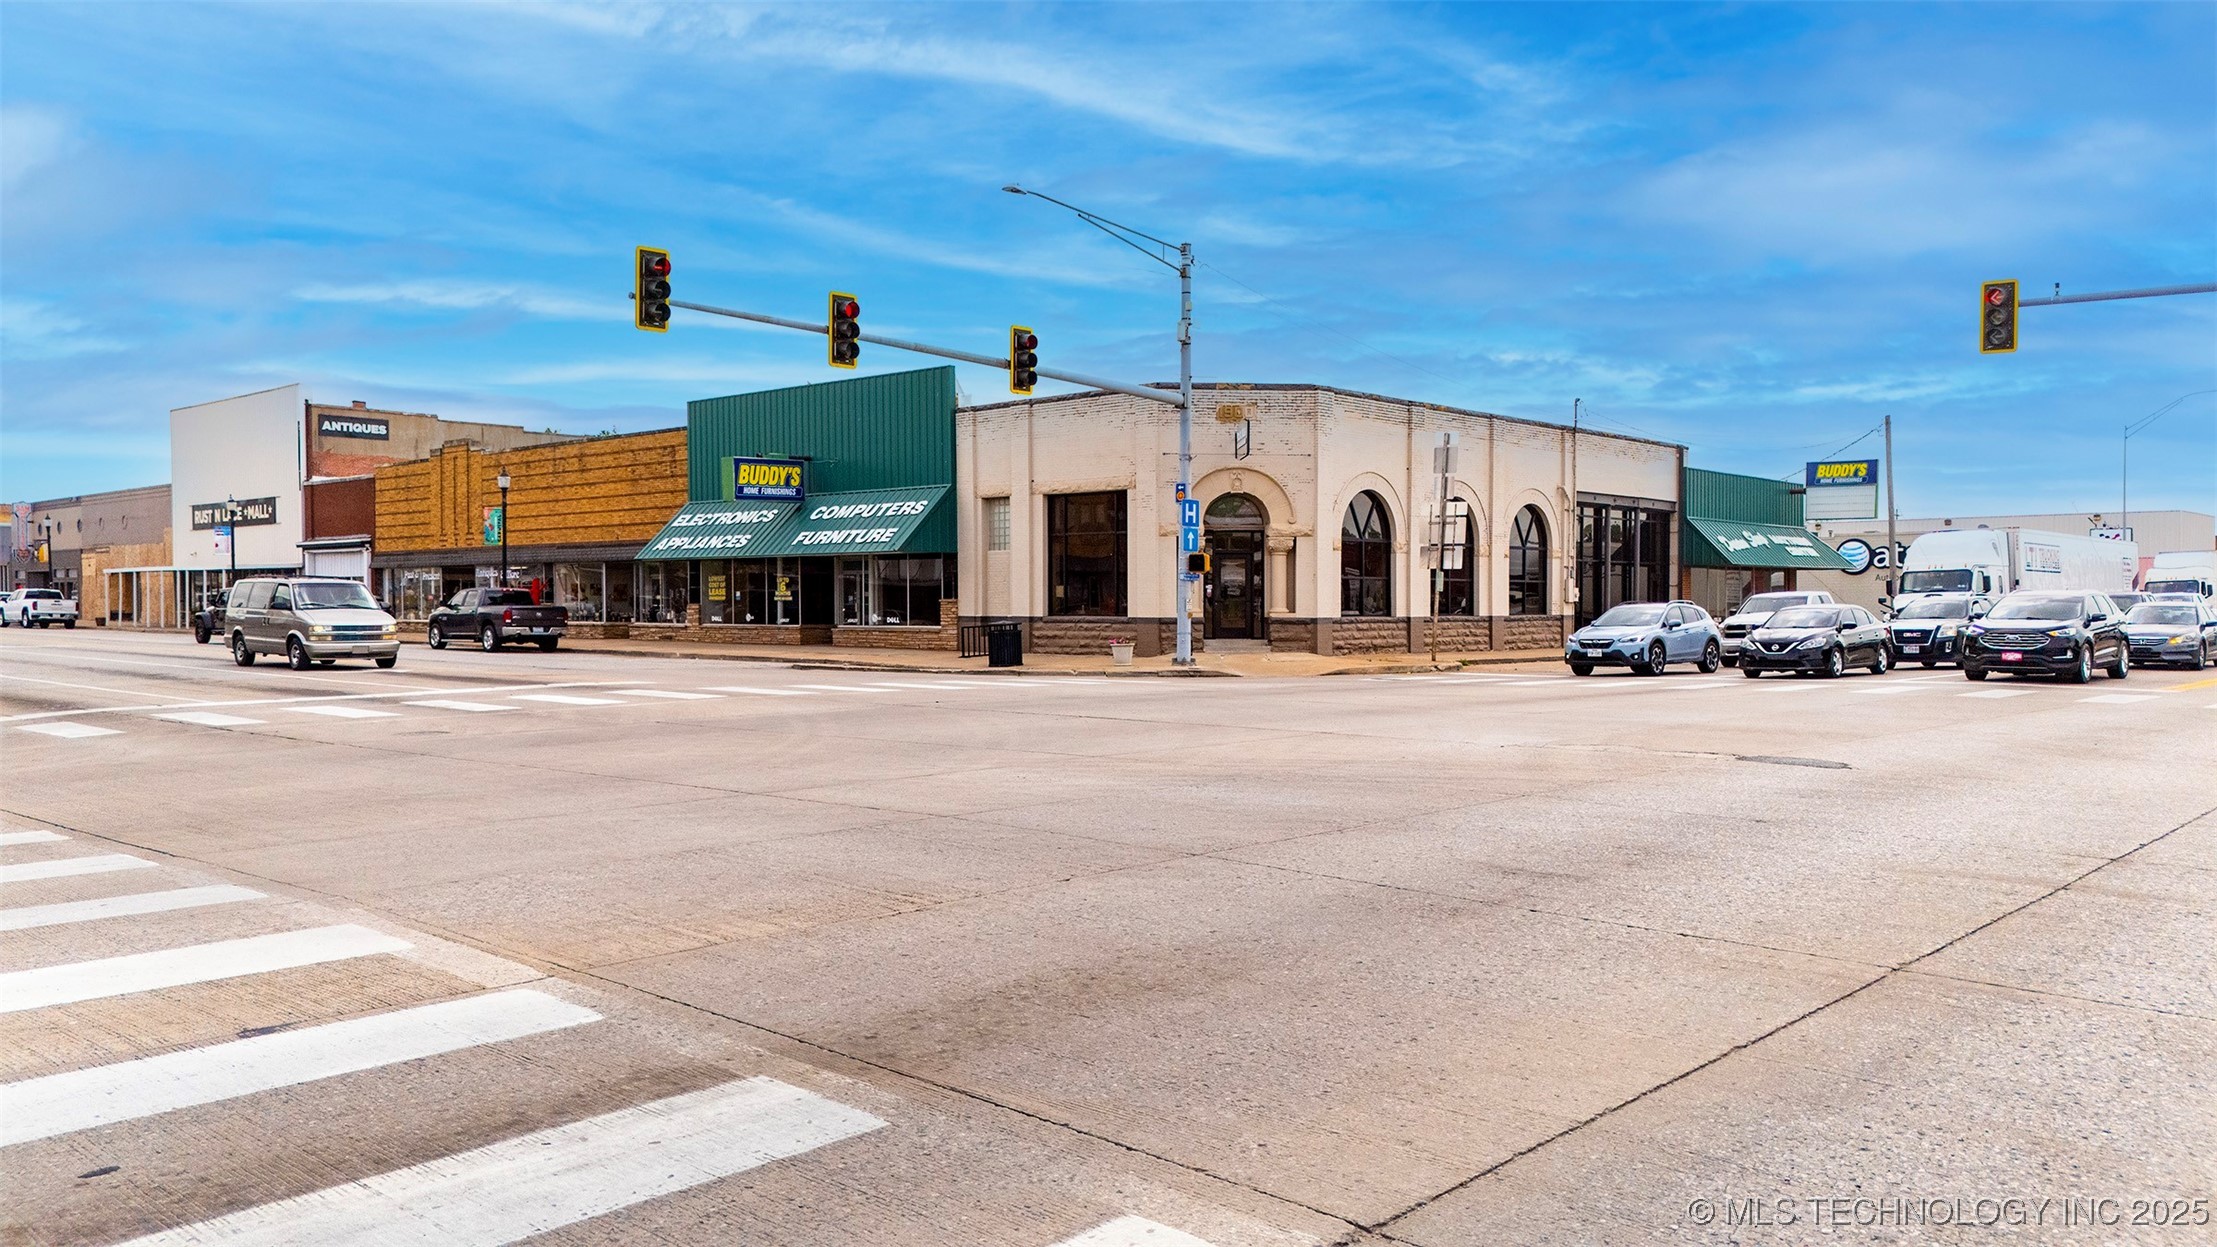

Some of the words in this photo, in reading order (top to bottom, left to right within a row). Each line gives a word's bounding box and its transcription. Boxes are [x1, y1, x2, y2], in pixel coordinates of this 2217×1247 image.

[321, 420, 388, 435] ANTIQUES
[738, 463, 801, 487] BUDDY'S
[1816, 463, 1868, 478] BUDDY'S
[760, 487, 797, 496] FURNISHINGS
[194, 509, 213, 524] RUST
[214, 508, 221, 523] N
[247, 504, 269, 520] MALL
[670, 509, 779, 528] ELECTRONICS
[809, 500, 928, 522] COMPUTERS
[1185, 503, 1197, 524] H
[652, 534, 752, 551] APPLIANCES
[791, 527, 899, 547] FURNITURE
[779, 582, 786, 591] 6
